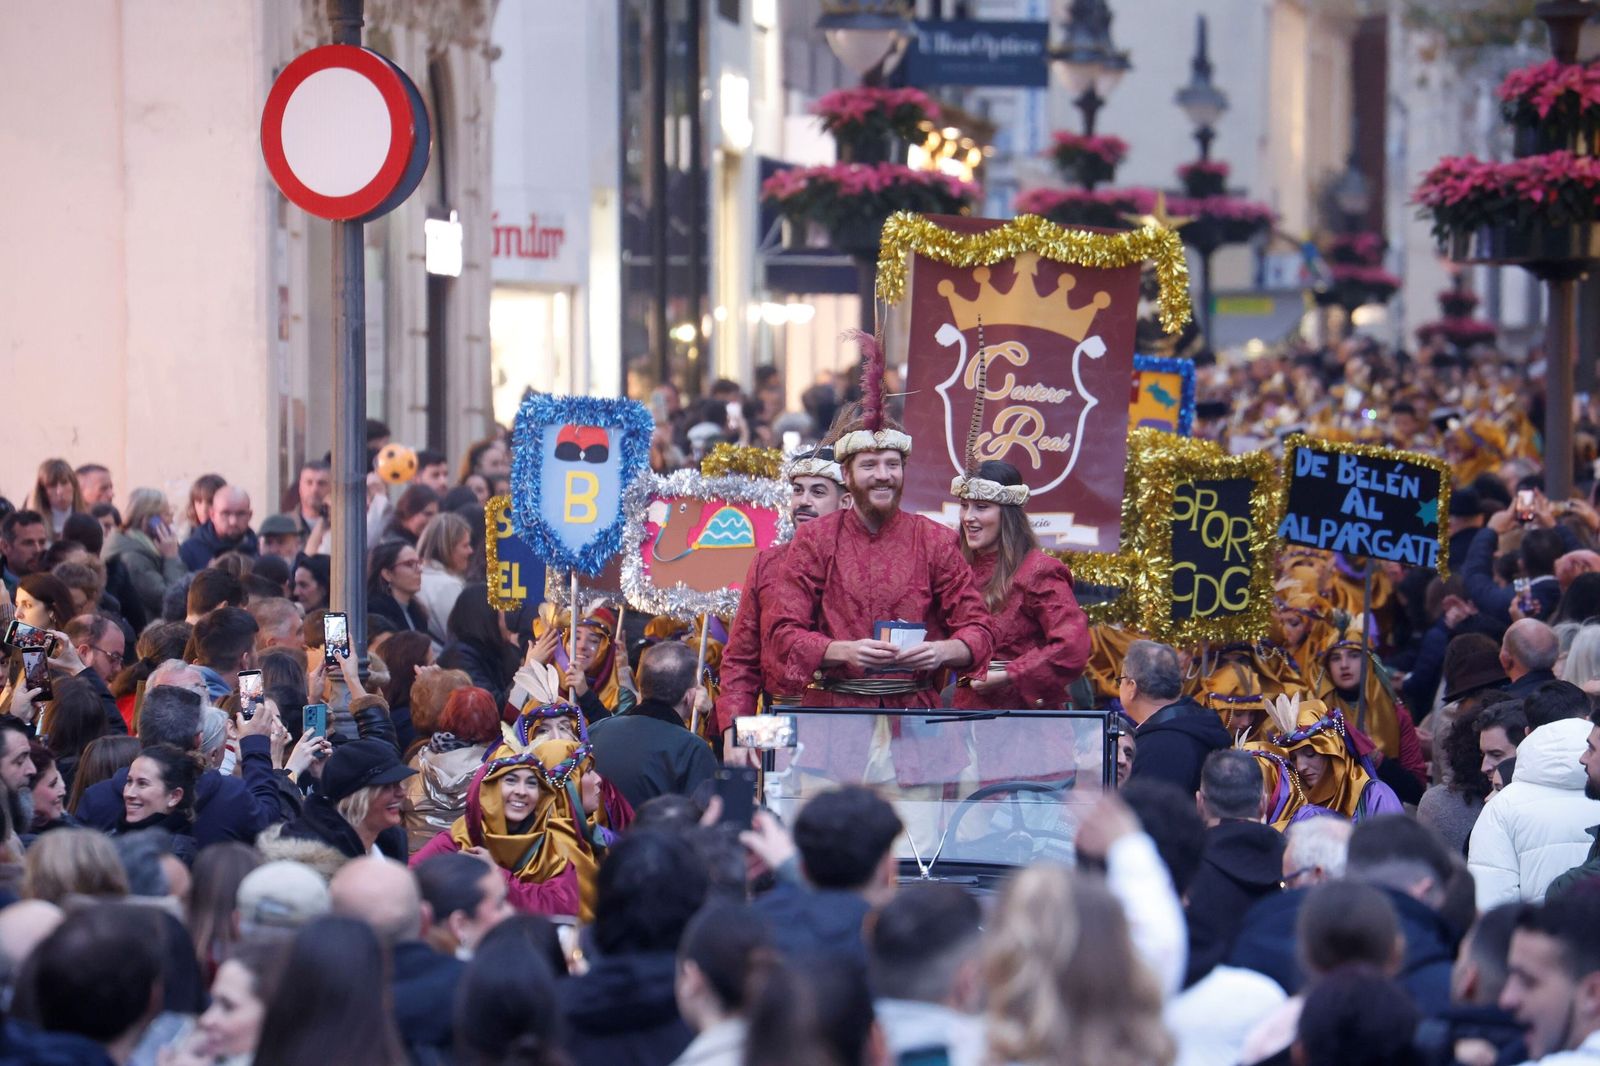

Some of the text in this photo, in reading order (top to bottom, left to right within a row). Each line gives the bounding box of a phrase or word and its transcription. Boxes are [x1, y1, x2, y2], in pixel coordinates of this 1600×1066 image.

[964, 341, 1071, 403] Cartero
[973, 405, 1071, 469] Real
[564, 470, 600, 524] B
[1340, 487, 1383, 520] AL
[1171, 561, 1250, 618] CDG
